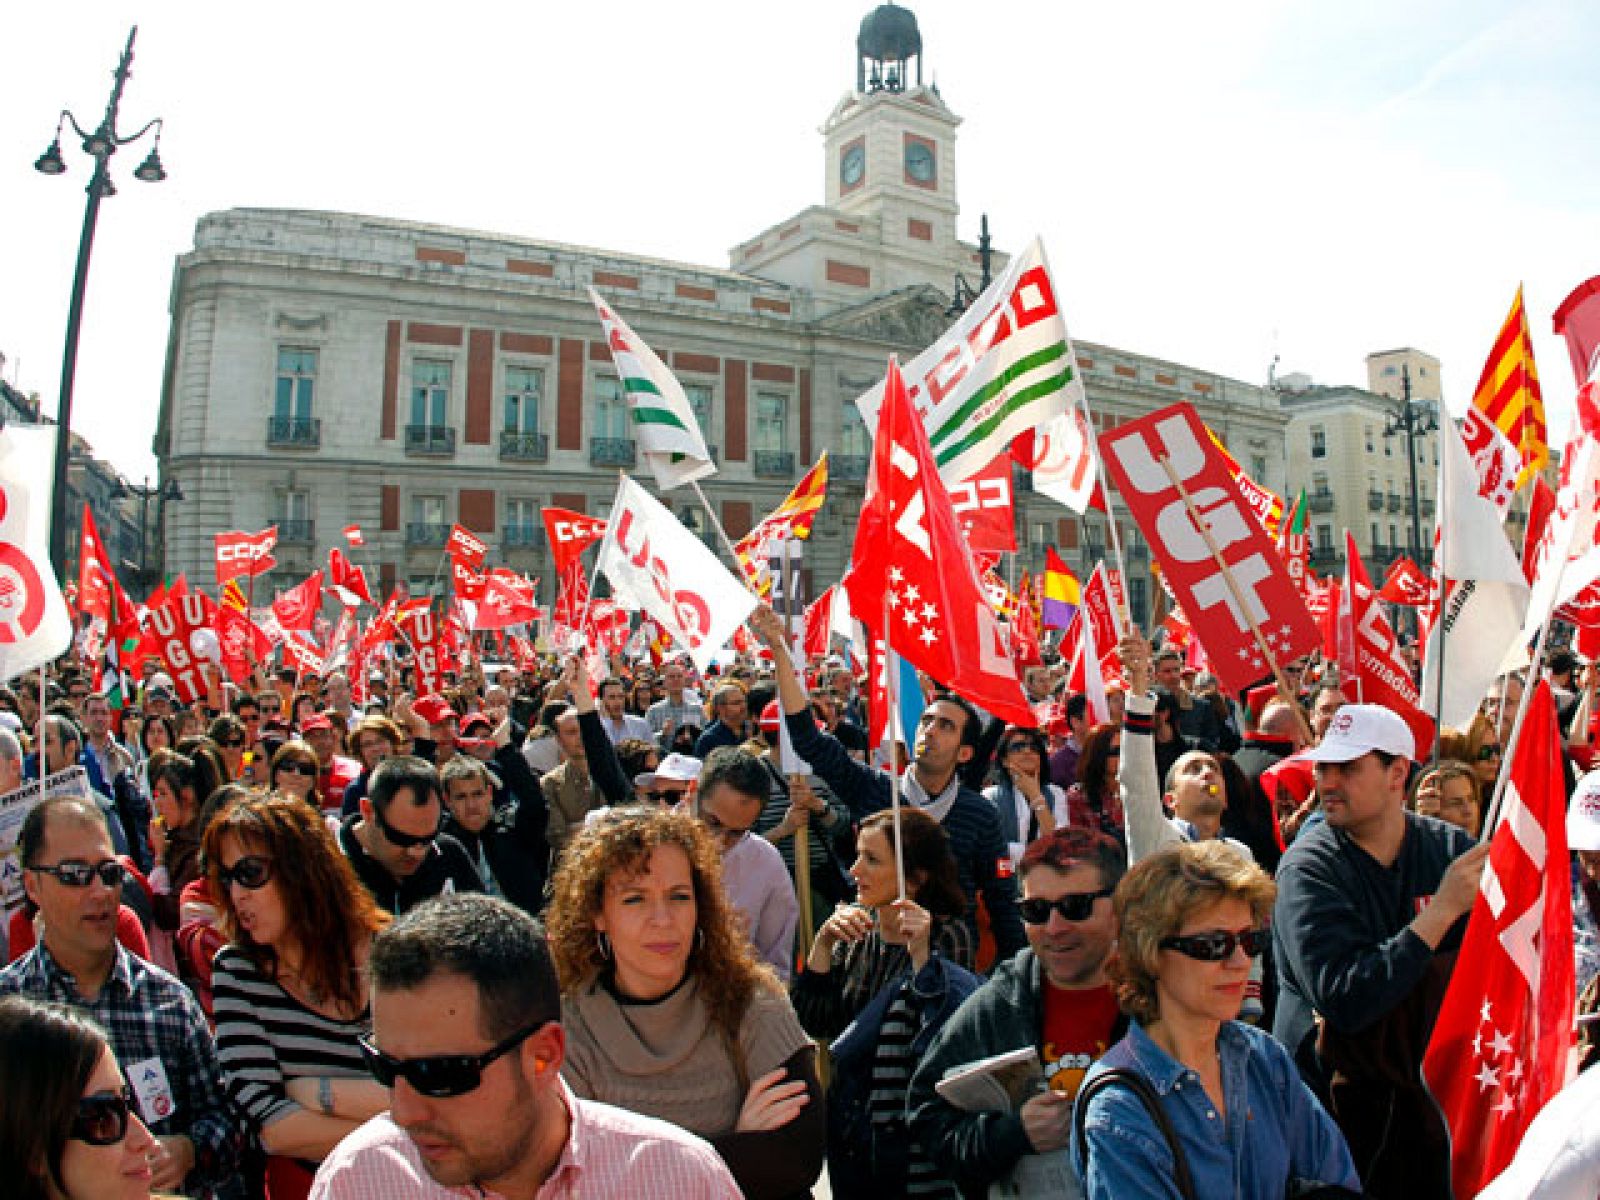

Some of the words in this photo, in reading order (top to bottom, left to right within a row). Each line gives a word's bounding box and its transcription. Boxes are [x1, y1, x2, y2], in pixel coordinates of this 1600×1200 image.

[1110, 413, 1273, 633] UGT
[151, 605, 200, 701] UGT
[414, 611, 438, 695] UGT
